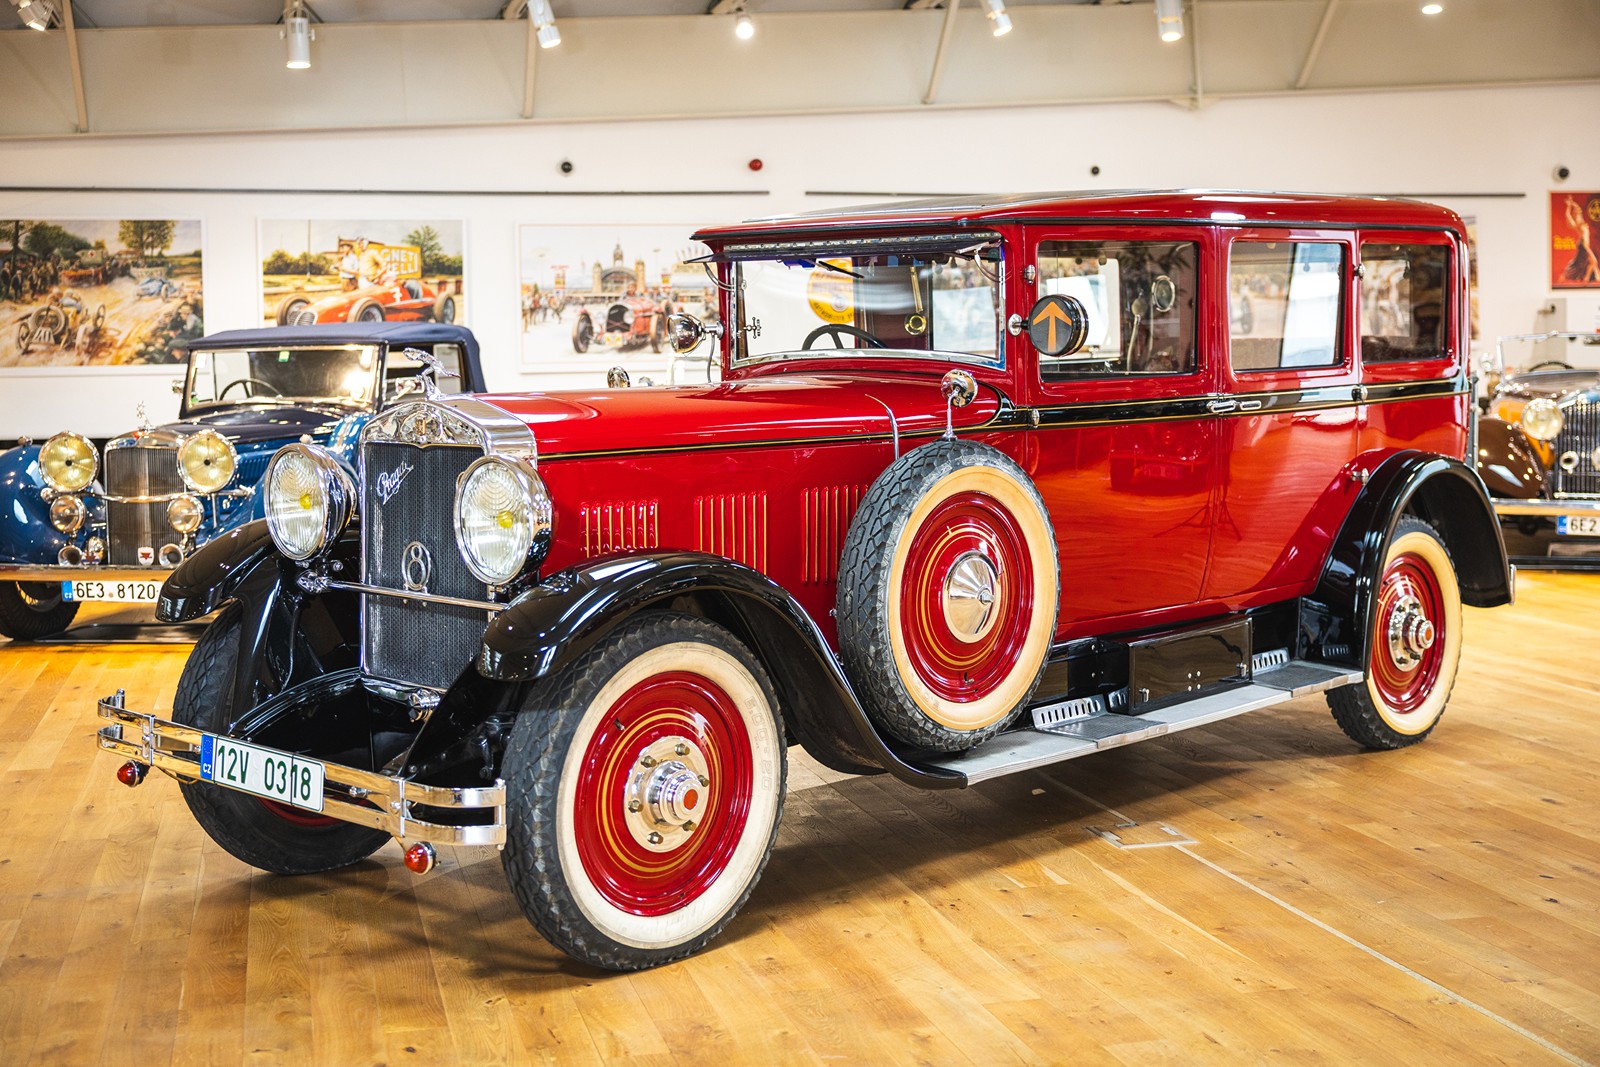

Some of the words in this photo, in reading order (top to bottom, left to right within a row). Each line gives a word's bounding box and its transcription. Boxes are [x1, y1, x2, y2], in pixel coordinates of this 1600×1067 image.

[380, 248, 418, 262] GNETI
[375, 461, 414, 505] Praga
[1570, 517, 1597, 532] 6E2
[76, 582, 105, 598] 6E3
[117, 583, 156, 600] 8120
[202, 763, 212, 774] CZ
[218, 745, 249, 784] 12V
[264, 757, 312, 801] 0318
